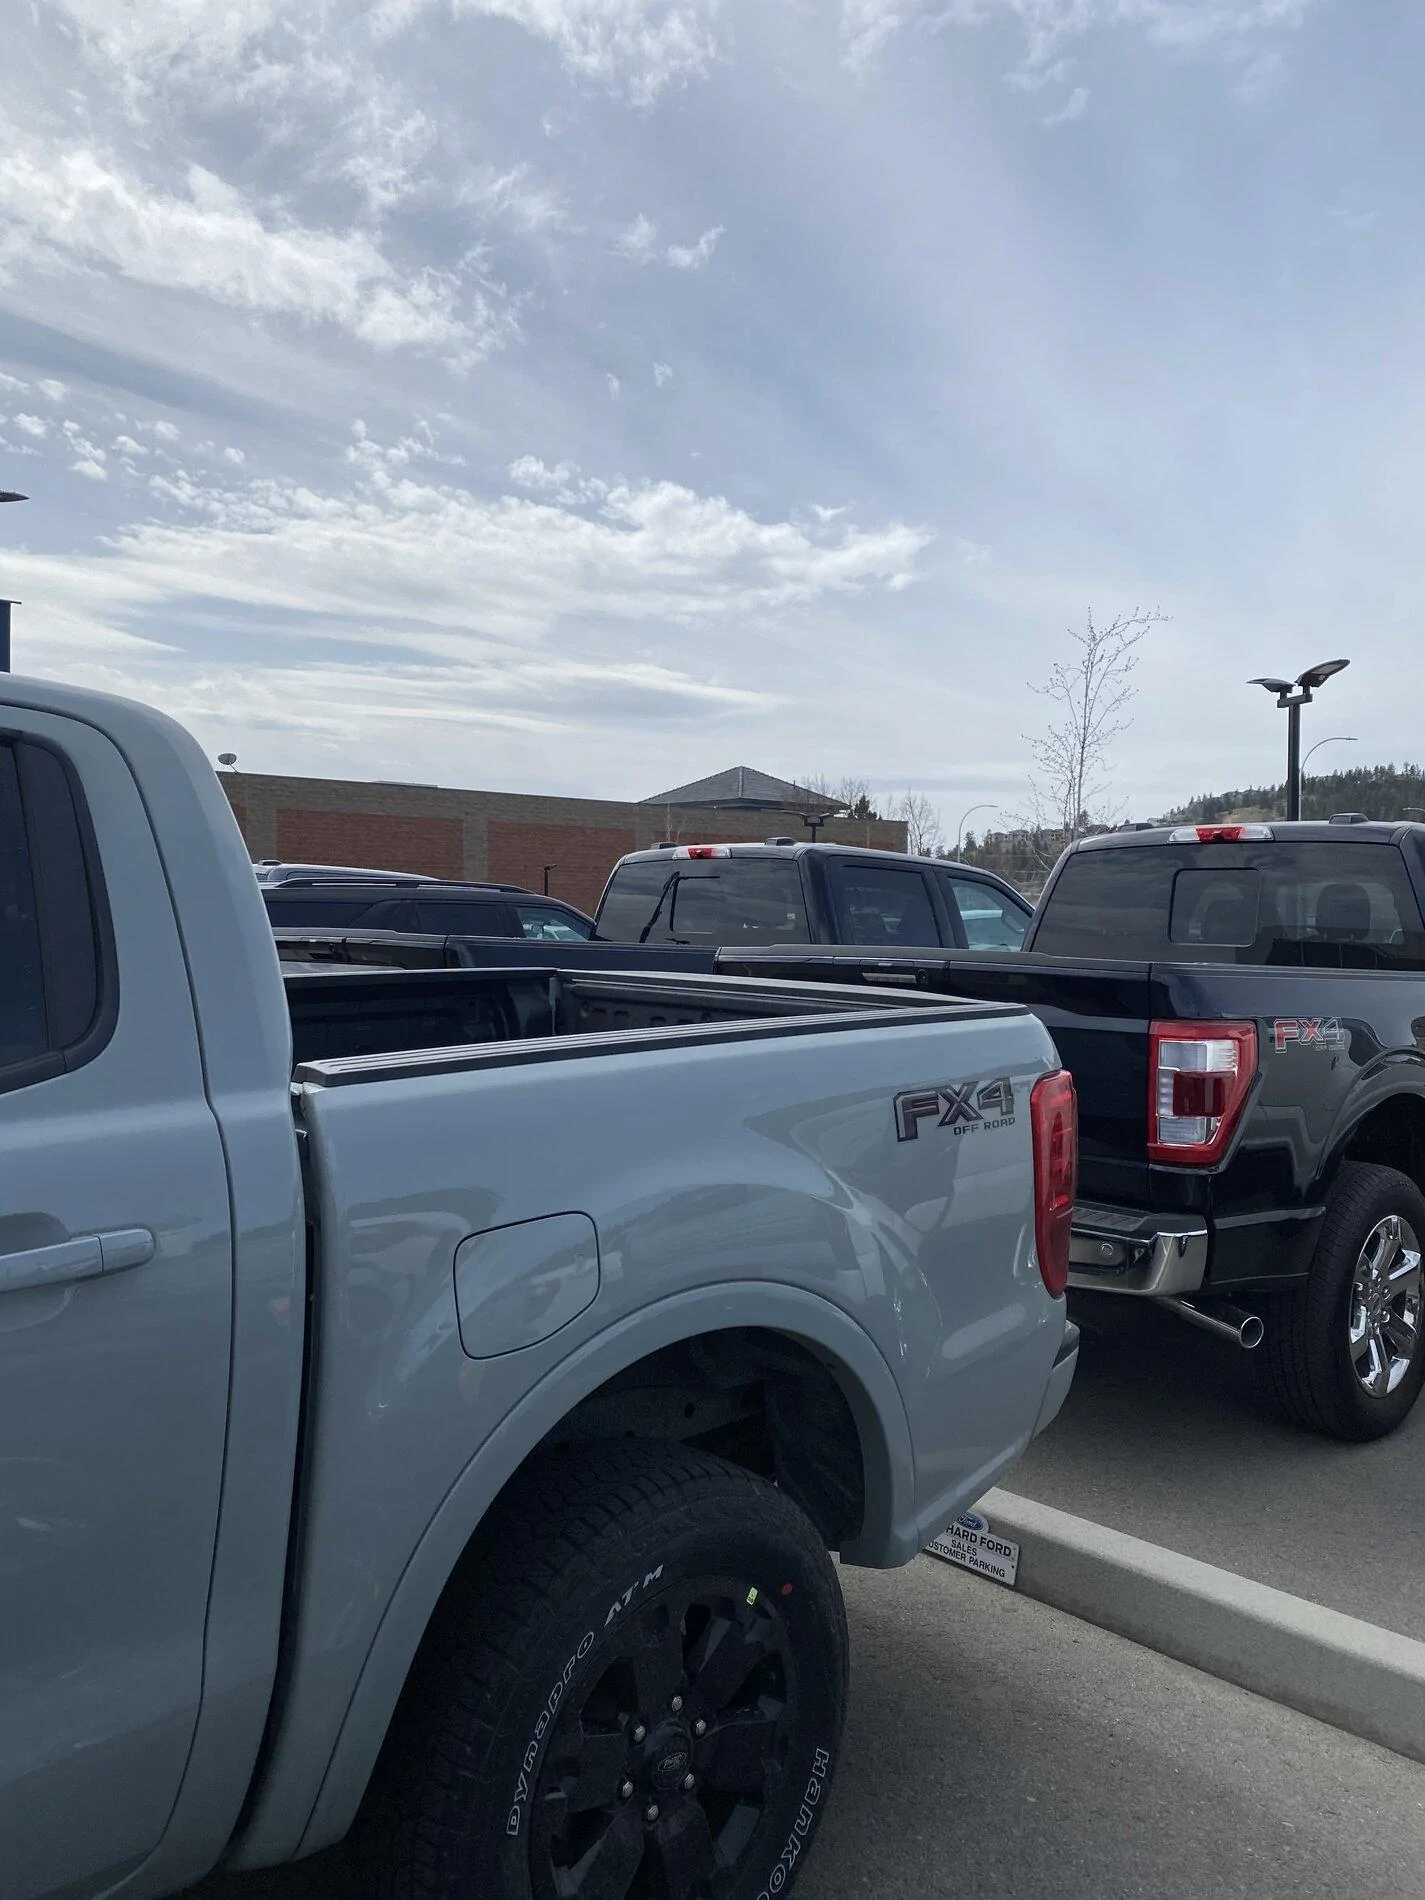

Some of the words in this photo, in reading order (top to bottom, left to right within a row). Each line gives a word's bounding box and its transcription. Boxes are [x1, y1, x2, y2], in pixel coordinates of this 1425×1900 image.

[1273, 1016, 1345, 1053] FX4
[893, 1076, 1015, 1142] FX4
[954, 1123, 979, 1136] OFF
[984, 1117, 1016, 1131] ROAD
[951, 1539, 978, 1557] SALES
[979, 1537, 1012, 1557] FORD
[969, 1556, 1006, 1578] PARKING
